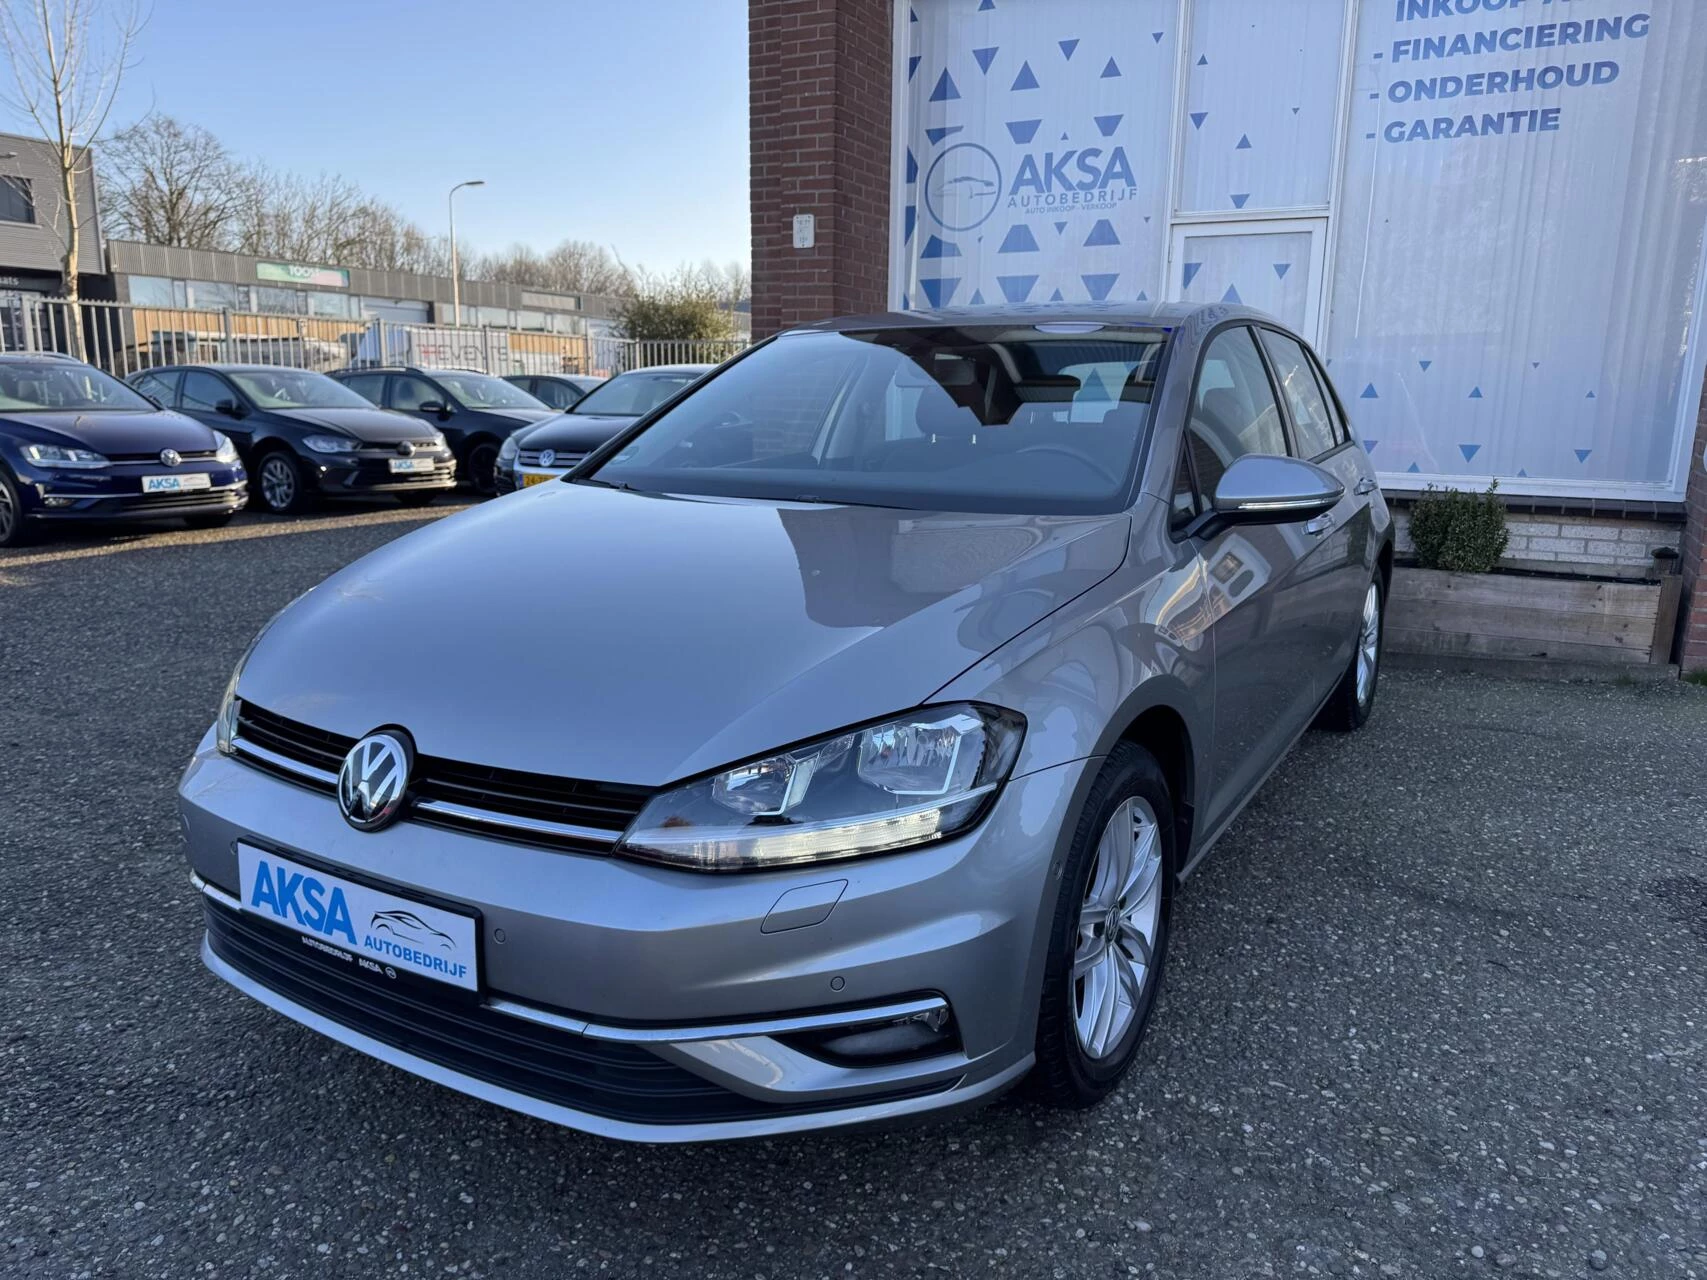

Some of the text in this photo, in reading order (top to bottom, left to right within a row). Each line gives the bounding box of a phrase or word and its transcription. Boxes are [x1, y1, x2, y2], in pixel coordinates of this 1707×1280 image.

[1391, 13, 1650, 63] FINANCIERING
[1387, 60, 1620, 104] ONDERHOUD
[1383, 107, 1561, 143] GARANTIE
[1008, 146, 1137, 196] AKSA
[1007, 188, 1138, 209] AUTOBEDRIJF
[148, 477, 180, 490] AKSA
[251, 860, 358, 946] AKSA
[363, 934, 468, 979] AUTOBEDRIJF
